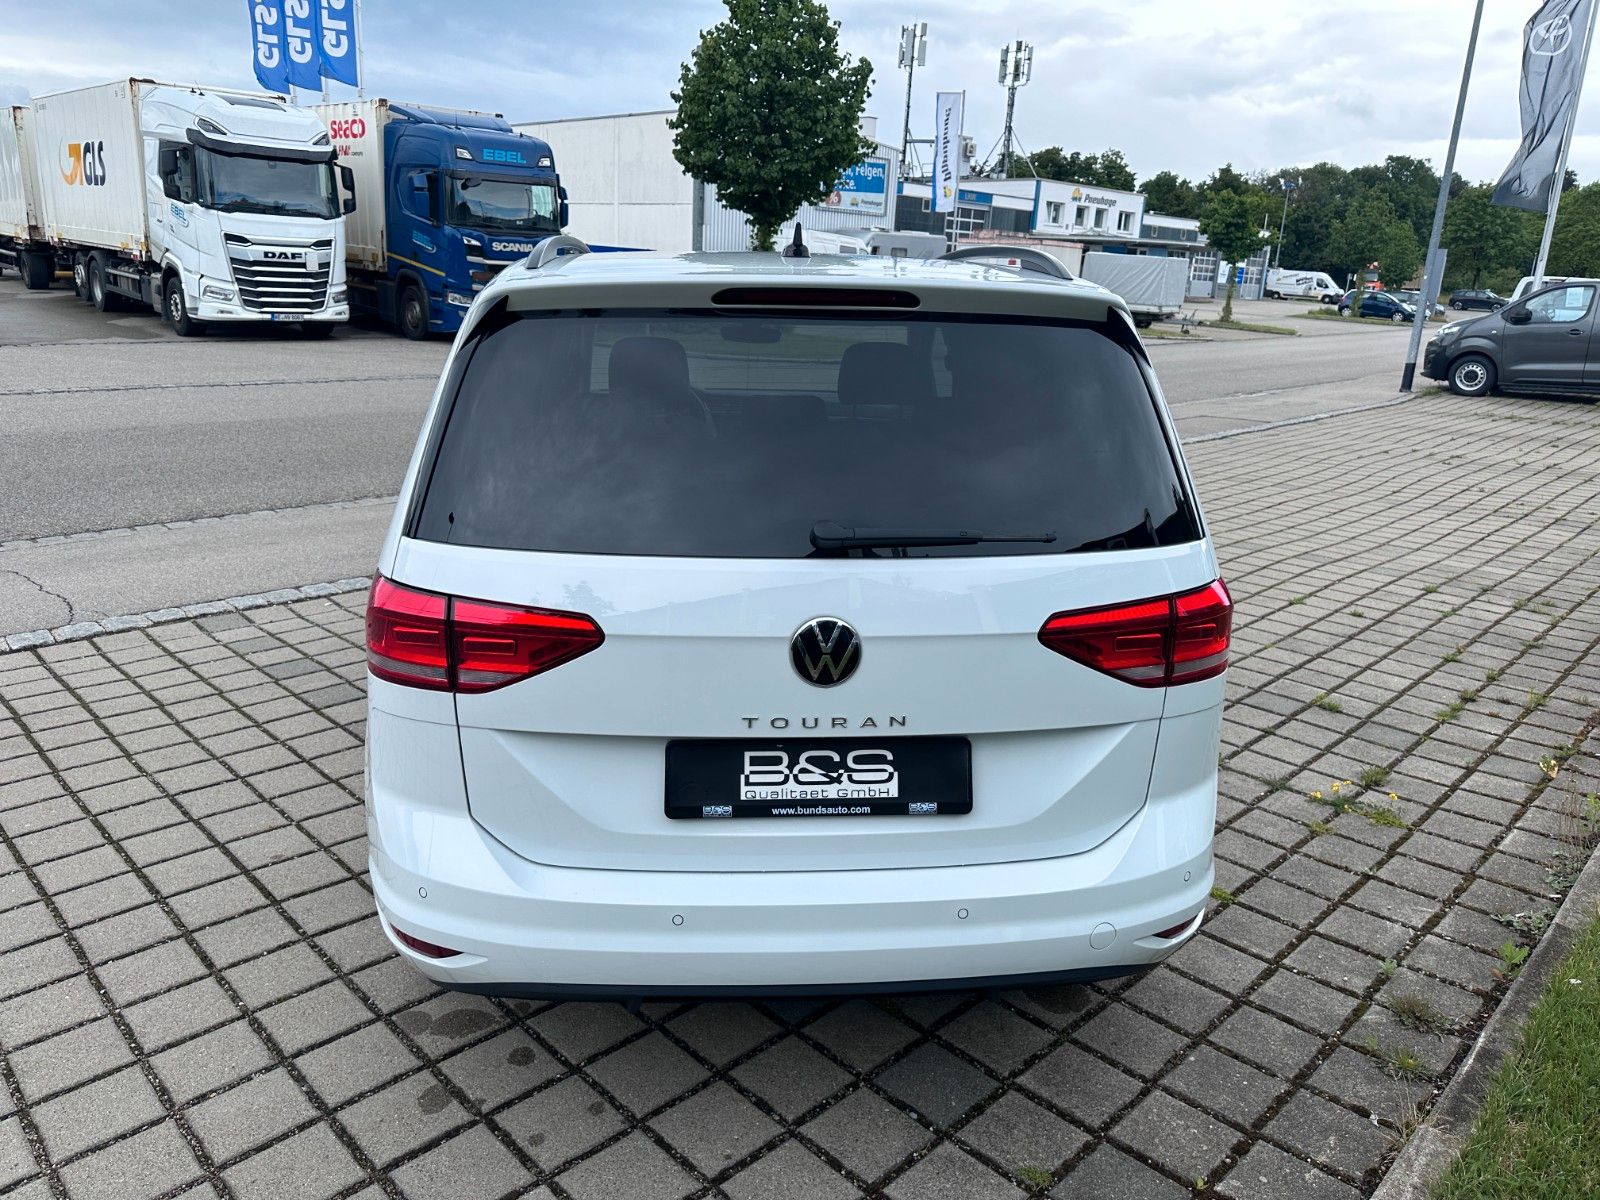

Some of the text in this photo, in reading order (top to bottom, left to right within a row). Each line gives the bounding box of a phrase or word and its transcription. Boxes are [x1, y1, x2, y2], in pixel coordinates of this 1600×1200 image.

[330, 117, 367, 140] seaco
[483, 148, 527, 164] EBEL
[82, 140, 107, 187] GLS
[1083, 193, 1117, 208] Pneuhage
[491, 241, 533, 253] SCANIA
[263, 252, 303, 260] DAF
[741, 715, 907, 729] TOURAN
[743, 749, 895, 787] B&S
[744, 786, 895, 800] Qualitaet GmbH.
[703, 805, 732, 814] B&S
[771, 804, 871, 815] www.bundsauto.com
[909, 802, 937, 811] B&S
